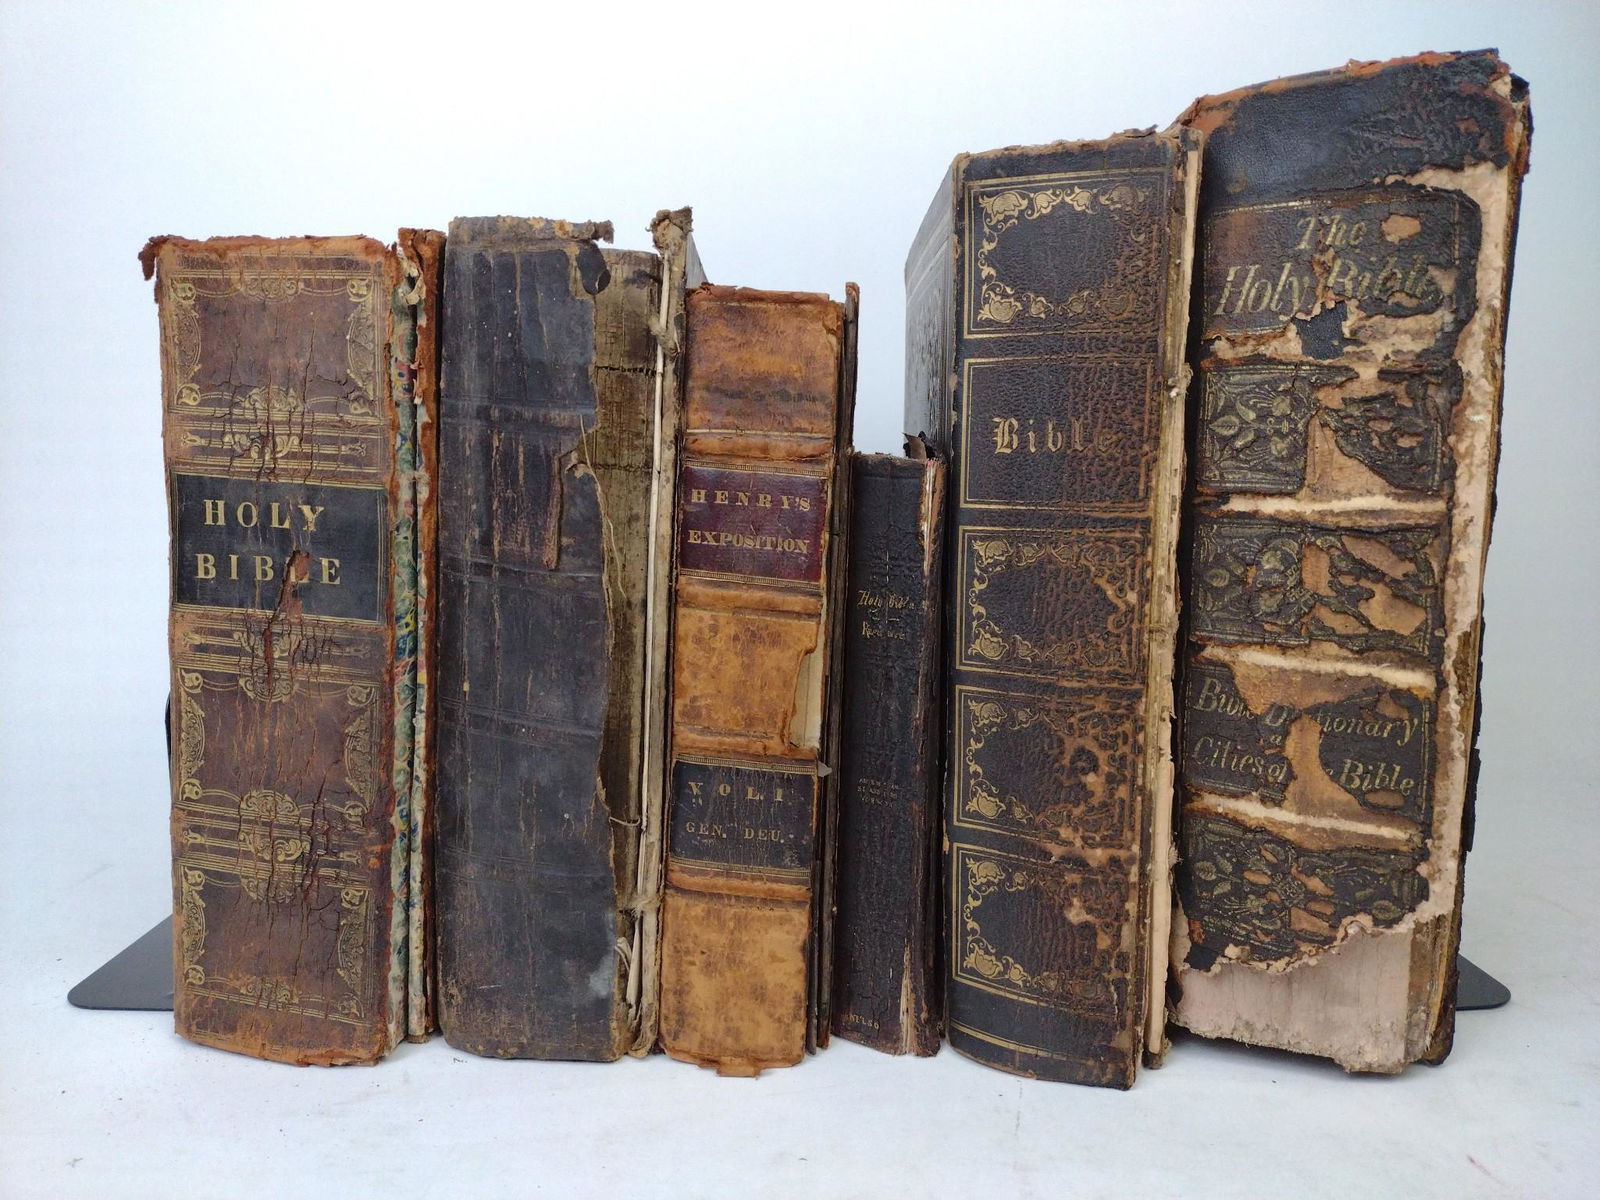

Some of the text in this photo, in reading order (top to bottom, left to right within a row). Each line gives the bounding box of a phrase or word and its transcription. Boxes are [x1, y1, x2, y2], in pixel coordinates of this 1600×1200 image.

[1297, 212, 1367, 250] The
[1213, 261, 1311, 323] Holy
[203, 499, 325, 532] HOLY
[690, 488, 811, 512] HENRY'S
[687, 528, 811, 555] EXPOSITION
[1191, 735, 1264, 776] Cities
[1338, 758, 1415, 797] Bible
